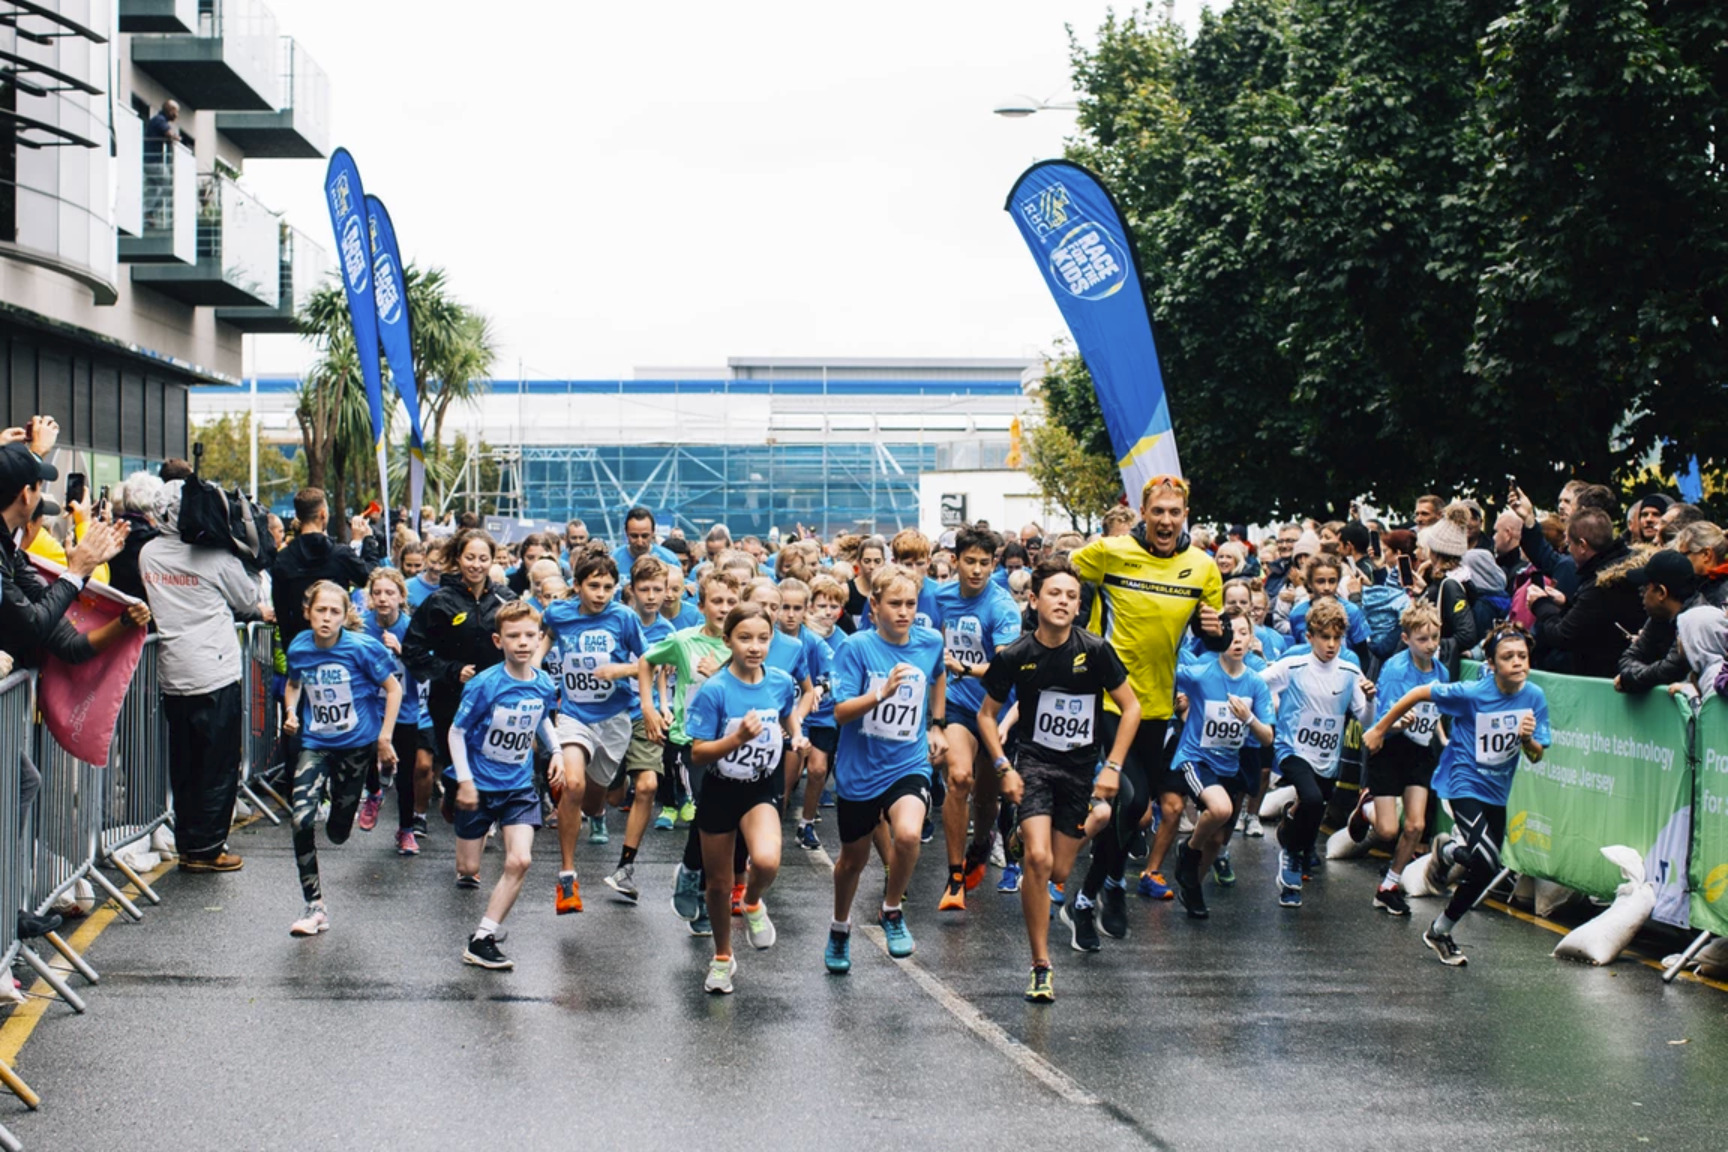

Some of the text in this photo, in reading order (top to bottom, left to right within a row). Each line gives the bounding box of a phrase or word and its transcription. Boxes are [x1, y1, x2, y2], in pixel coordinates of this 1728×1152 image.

[1024, 203, 1050, 234] RBC
[1067, 241, 1101, 287] FOR THE
[1078, 231, 1120, 281] RACE
[1052, 247, 1090, 295] KIDS
[1120, 579, 1192, 596] #IAMSUPERLEAGUE
[584, 635, 608, 646] RACE
[321, 669, 342, 680] RACE
[313, 702, 351, 724] 0607
[871, 703, 918, 727] 1071
[1039, 712, 1090, 739] 0894
[489, 729, 533, 751] 0908
[1205, 719, 1245, 739] 099
[1298, 728, 1339, 750] 0988
[725, 743, 775, 769] 0251
[1593, 731, 1611, 754] the
[1613, 734, 1675, 772] technology
[1548, 760, 1577, 788] League
[1579, 766, 1615, 797] Jersey
[1704, 789, 1722, 815] for
